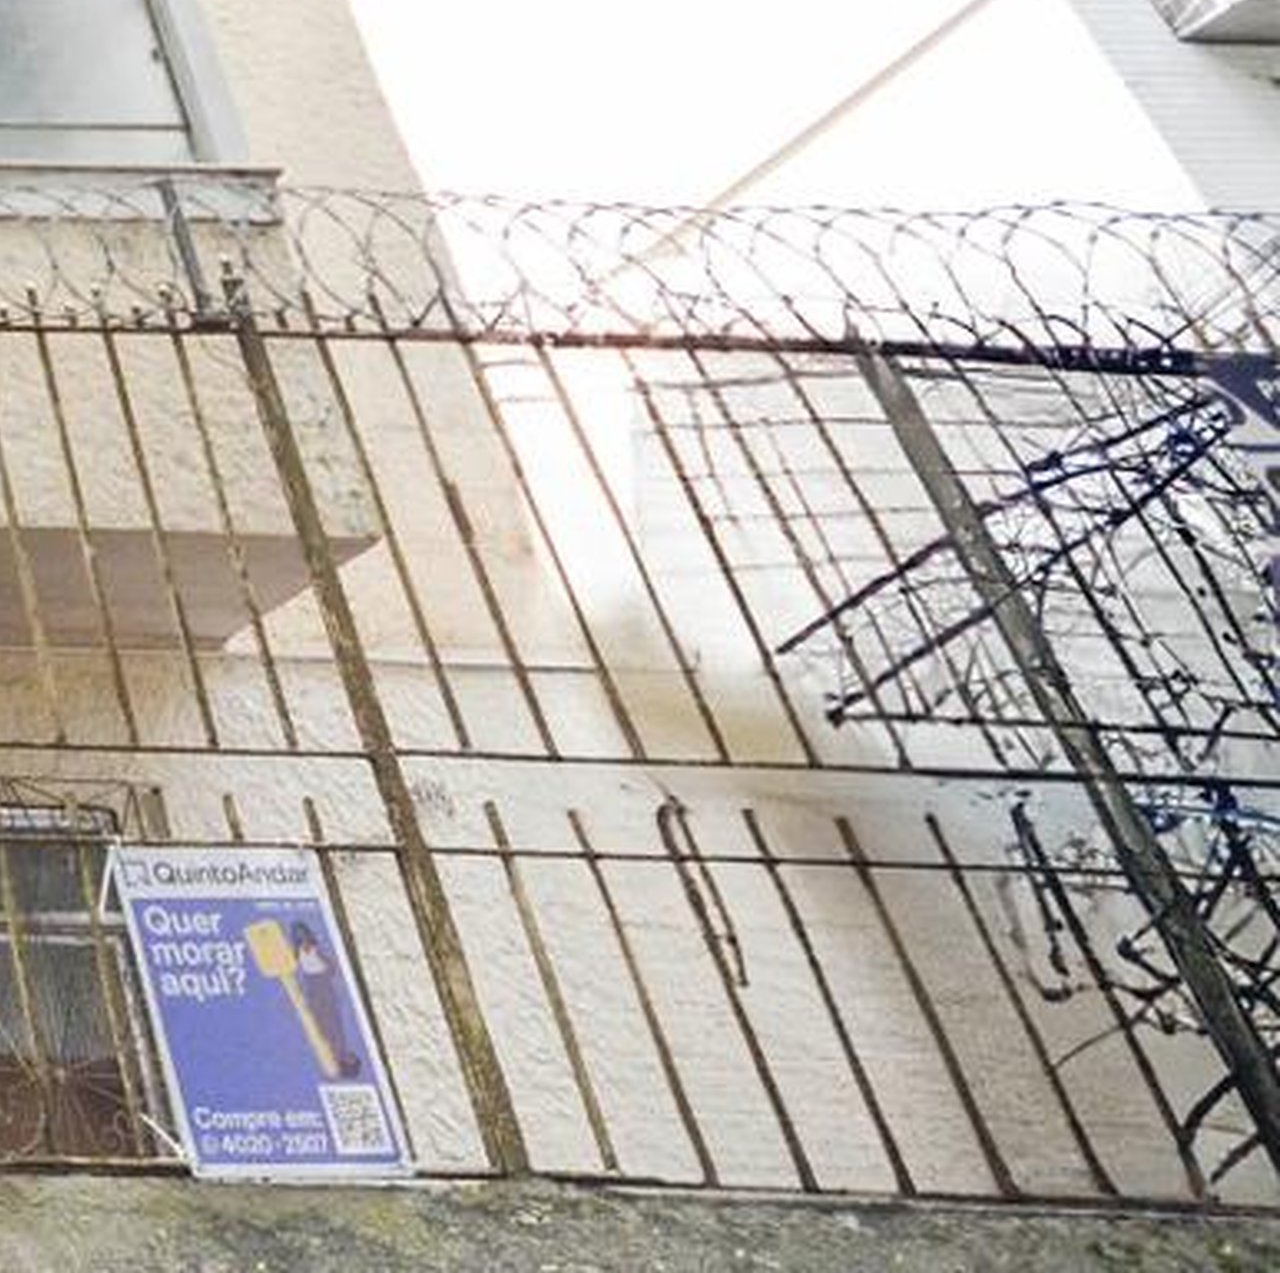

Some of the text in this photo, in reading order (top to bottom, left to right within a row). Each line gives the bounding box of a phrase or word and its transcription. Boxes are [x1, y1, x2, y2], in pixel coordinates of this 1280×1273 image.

[143, 905, 221, 936] Quer
[151, 941, 244, 965] morar
[161, 964, 246, 1003] aqui?
[193, 1107, 281, 1130] Compre
